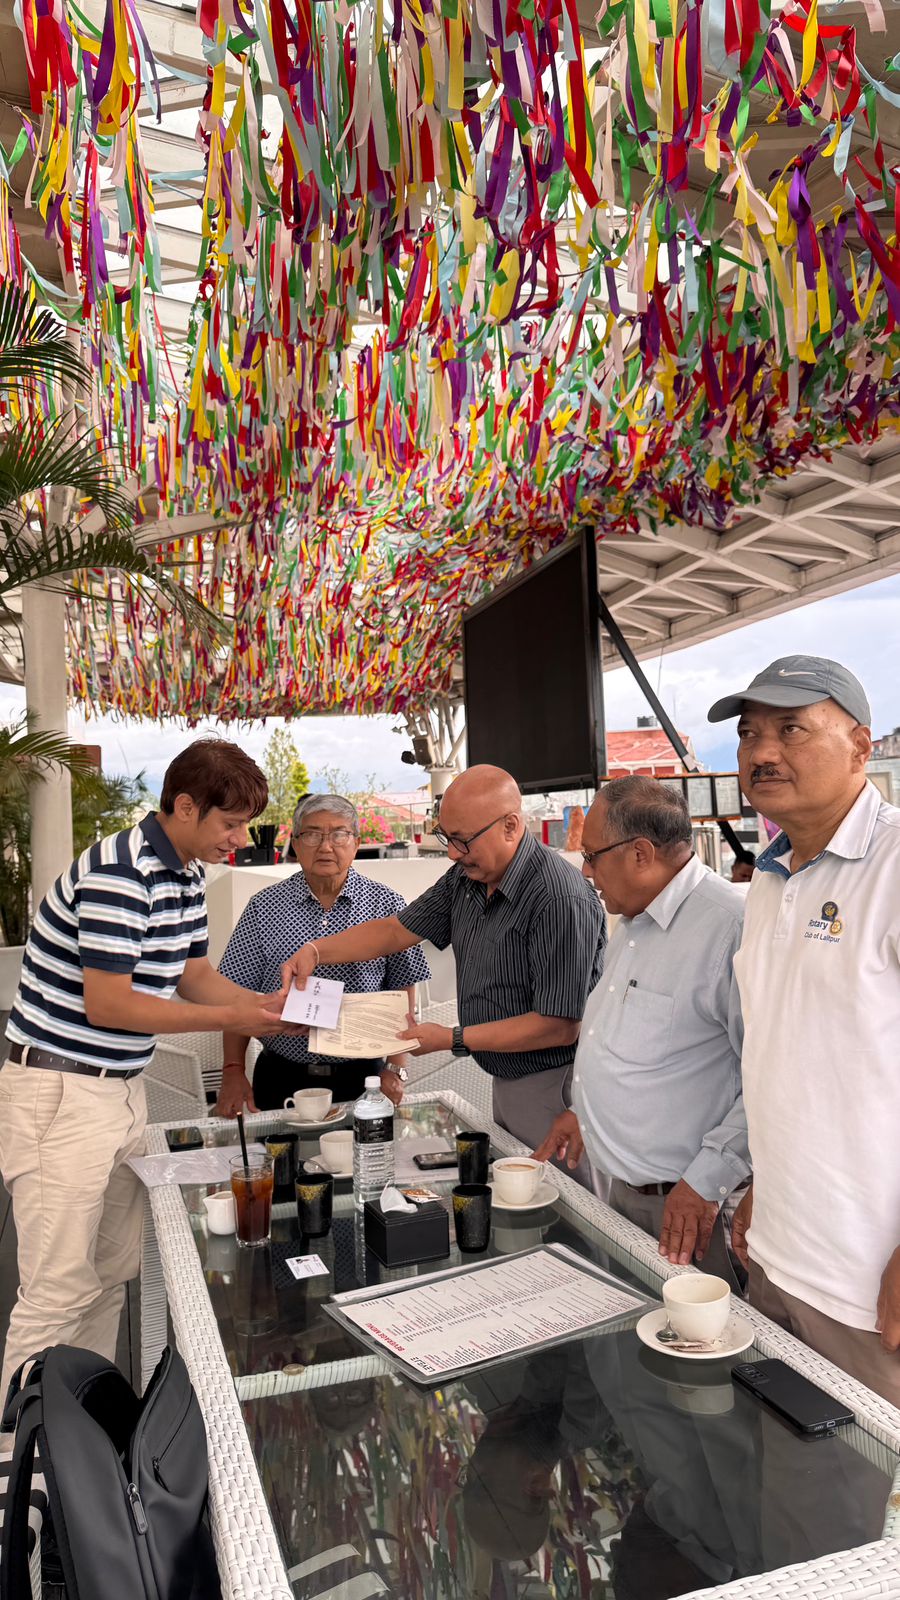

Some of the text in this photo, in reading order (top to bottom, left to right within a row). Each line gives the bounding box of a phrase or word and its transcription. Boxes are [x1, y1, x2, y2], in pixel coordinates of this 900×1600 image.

[808, 920, 828, 930] Rotary
[819, 934, 840, 943] Lalitpur
[378, 1332, 405, 1351] BEVERAGE
